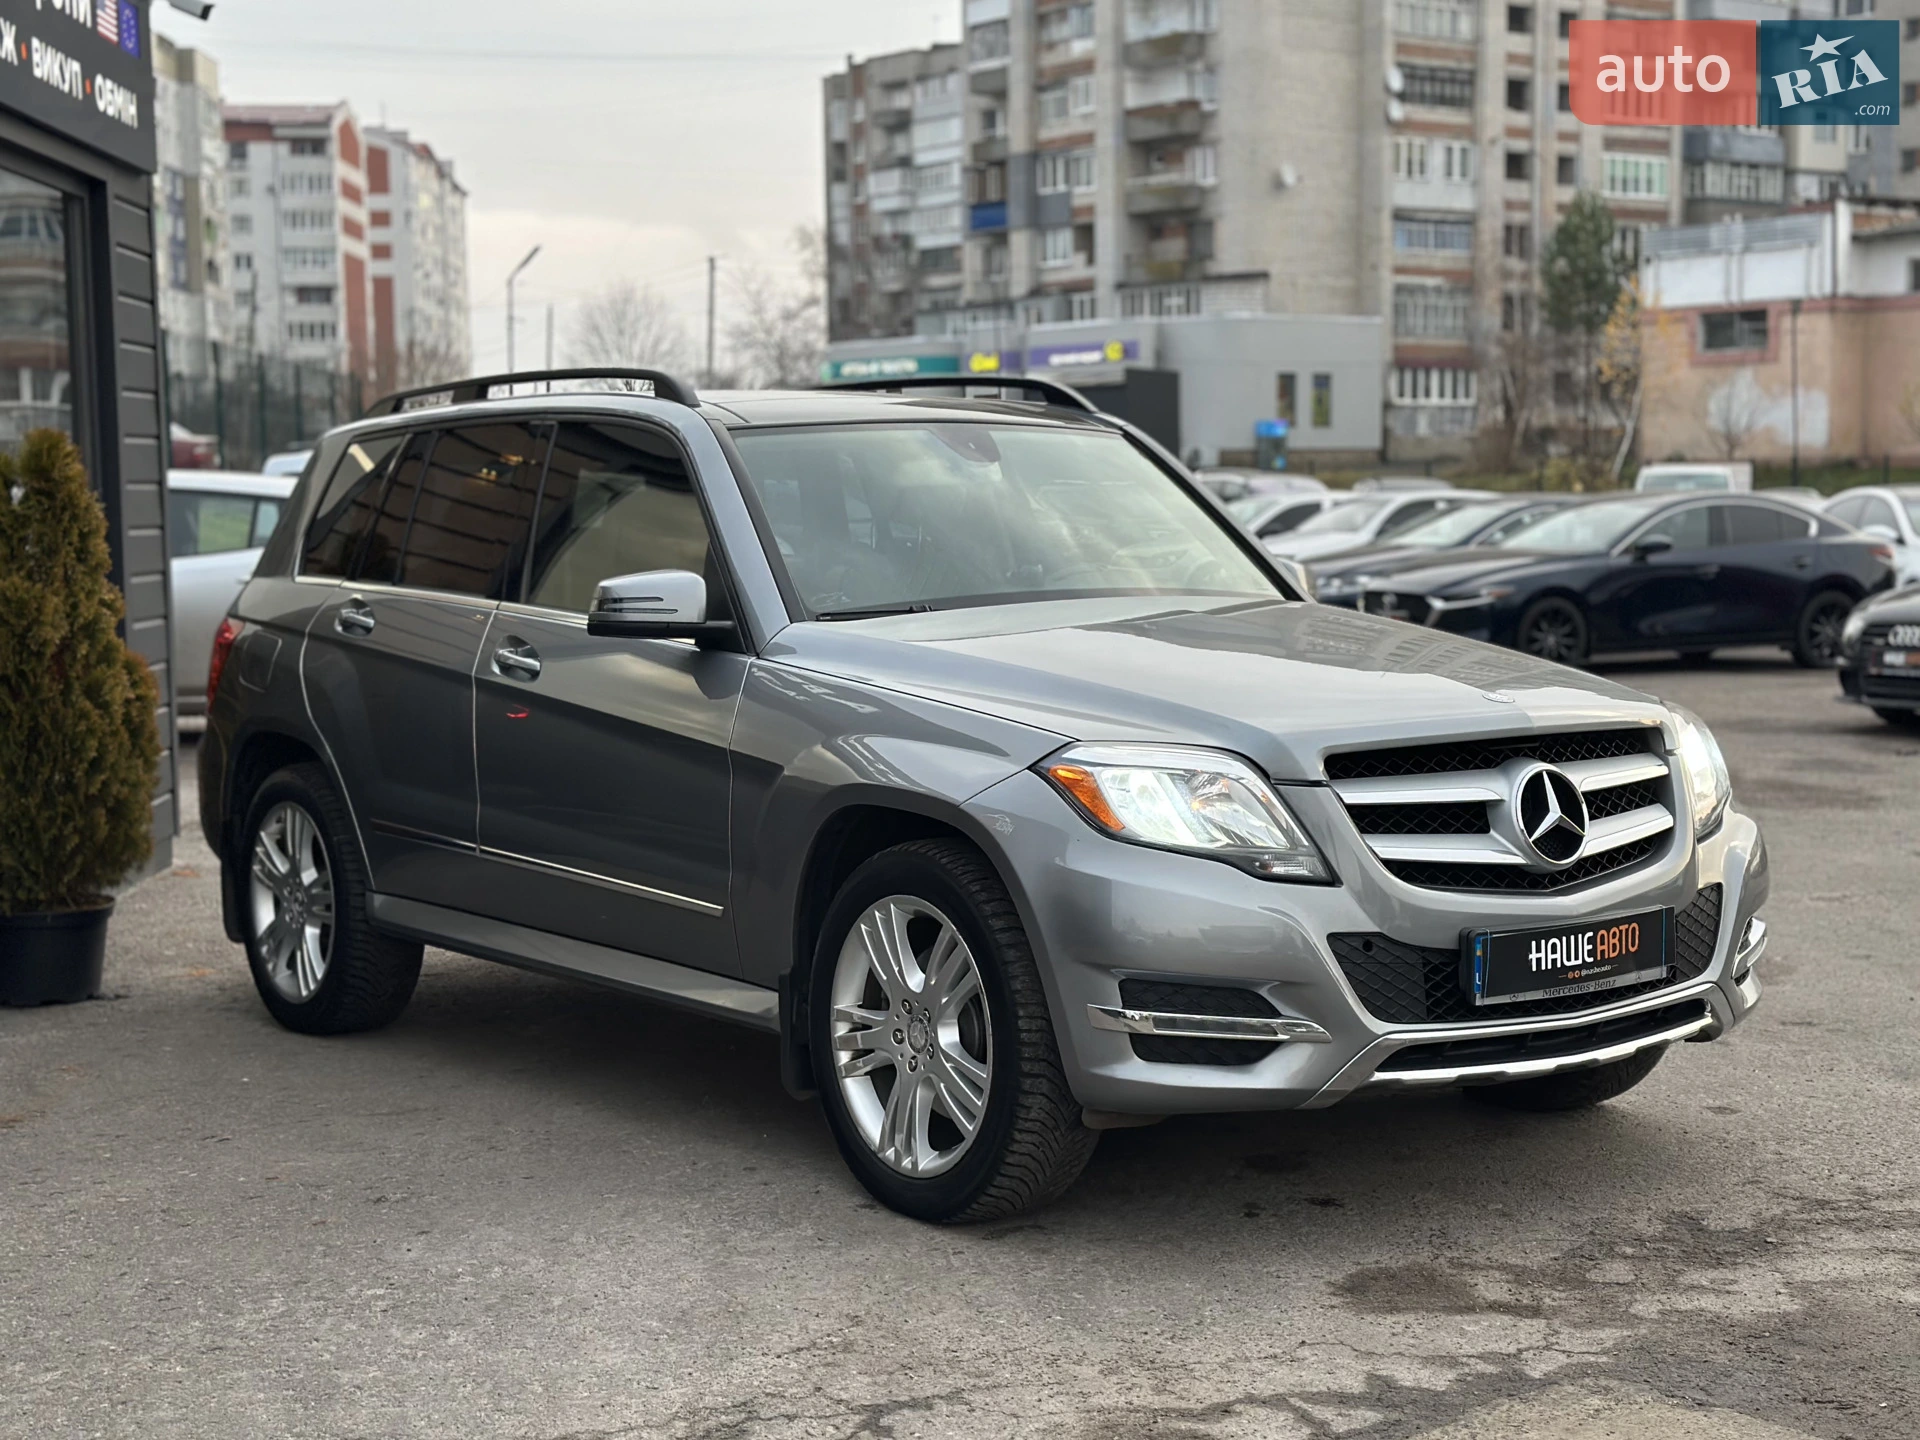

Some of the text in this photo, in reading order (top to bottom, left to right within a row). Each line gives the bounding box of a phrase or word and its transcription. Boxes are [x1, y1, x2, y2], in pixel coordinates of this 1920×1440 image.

[0, 17, 138, 129] Ж ВИКУП ОБМІН
[1542, 978, 1617, 998] Mercedes-Benz
